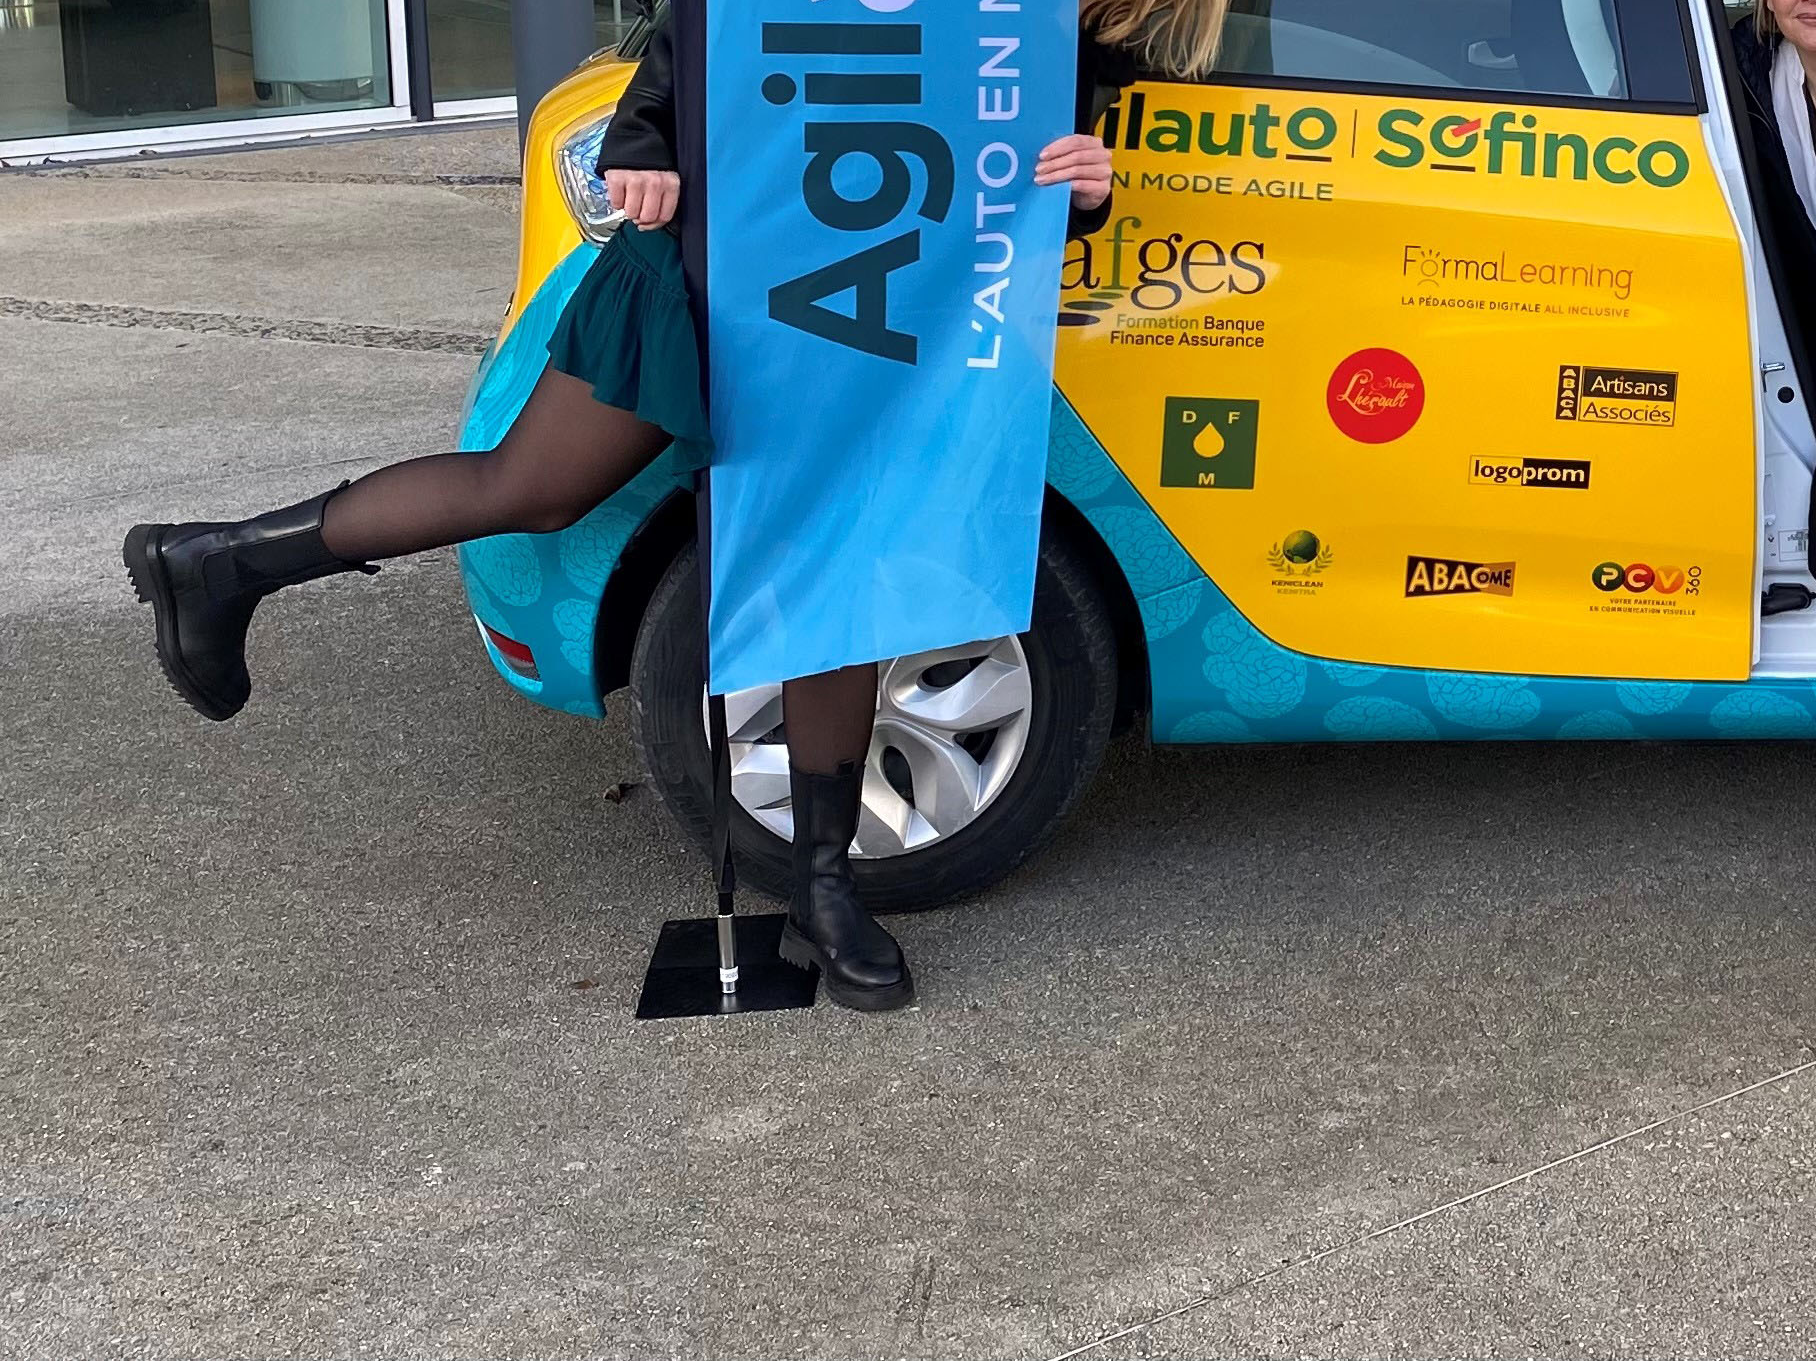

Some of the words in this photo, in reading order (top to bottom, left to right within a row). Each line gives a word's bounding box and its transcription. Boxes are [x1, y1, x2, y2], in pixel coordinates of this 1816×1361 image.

[978, 37, 1021, 121] EN
[1102, 92, 1338, 162] ilauto
[1373, 108, 1690, 188] Sofinco
[1110, 170, 1131, 189] N
[1140, 173, 1233, 195] MODE
[1242, 178, 1334, 202] AGILE
[967, 142, 1019, 369] L'AUTO
[1060, 216, 1267, 311] afges
[1402, 244, 1634, 300] FormaLearning
[1401, 296, 1415, 306] LA
[1418, 294, 1486, 311] PÉDAGOGIE
[1489, 301, 1542, 314] DIGITALE
[1544, 305, 1565, 315] ALL
[1568, 306, 1631, 319] INCLUSIVE
[1115, 314, 1199, 330] Formation
[1203, 315, 1265, 334] Banque
[1110, 330, 1175, 346] Finance
[1178, 331, 1265, 348] Assurance
[1559, 368, 1577, 418] ABACA
[1590, 374, 1669, 398] Artisans
[1182, 410, 1197, 423] D
[1228, 411, 1241, 424] F
[1582, 401, 1672, 424] Associés
[1198, 472, 1216, 486] M
[1474, 459, 1585, 485] logoprom
[1600, 566, 1681, 590] PCV
[1686, 565, 1703, 596] 360
